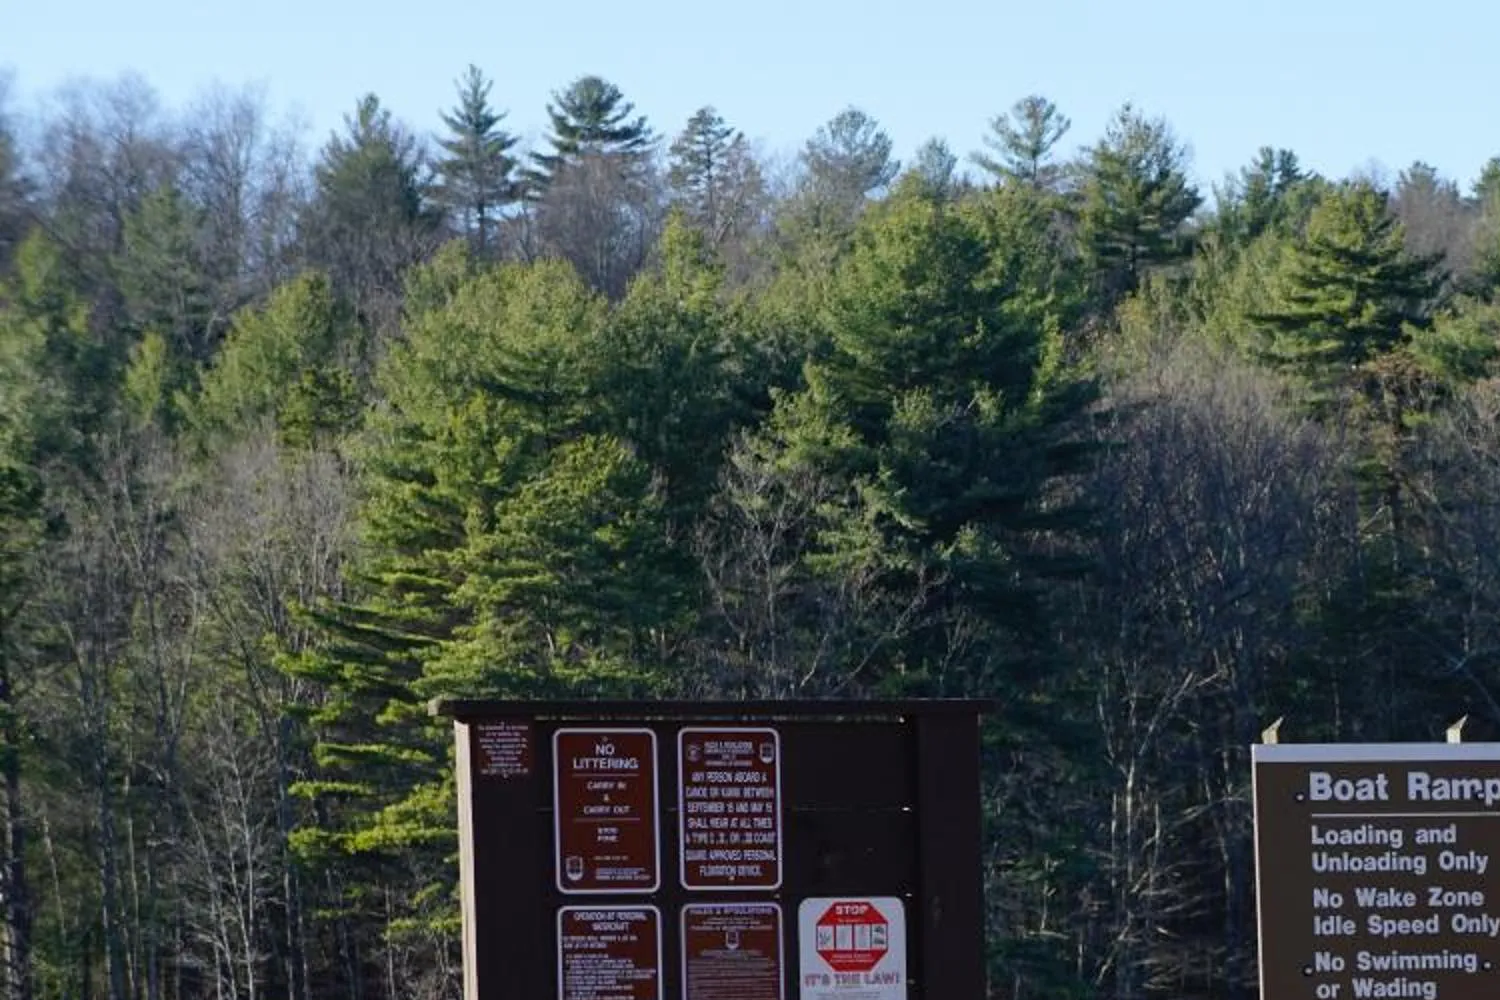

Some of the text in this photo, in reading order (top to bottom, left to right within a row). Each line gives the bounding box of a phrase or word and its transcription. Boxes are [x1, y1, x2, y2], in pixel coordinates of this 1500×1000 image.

[595, 743, 615, 756] NO
[572, 757, 640, 769] LITTERING
[706, 771, 732, 783] PERSON
[1309, 771, 1389, 800] Boat
[613, 805, 631, 814] OUT
[1311, 824, 1456, 848] Loading and
[1311, 851, 1489, 875] Unloading Only
[1312, 887, 1485, 908] No Wake Zone
[835, 904, 869, 915] STOP
[1314, 914, 1500, 938] Idle Speed Only
[1315, 950, 1478, 973] No Swimming
[804, 972, 900, 987] IT'S THE LAW!
[1316, 978, 1437, 1000] or Wading
